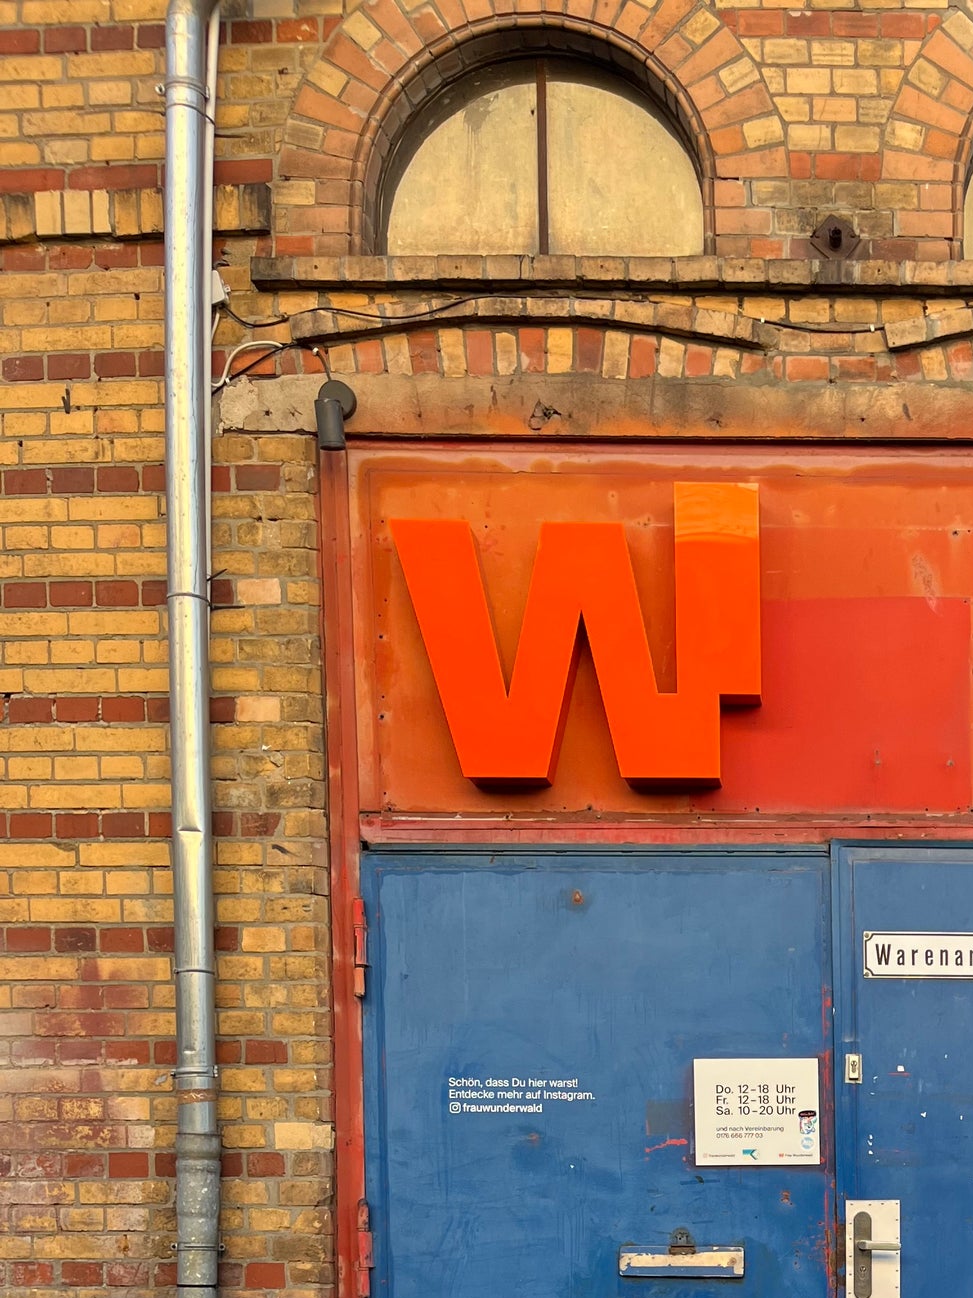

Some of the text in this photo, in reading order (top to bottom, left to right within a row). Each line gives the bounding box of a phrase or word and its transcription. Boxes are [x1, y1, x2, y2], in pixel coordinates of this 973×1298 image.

[448, 1077, 579, 1088] Schön, dass Du hier warst!
[715, 1084, 734, 1094] Do.
[776, 1084, 796, 1094] Uhr
[448, 1089, 596, 1101] Entdecke mehr auf Instagram.
[716, 1095, 729, 1104] Fr.
[776, 1095, 796, 1104] Uhr
[462, 1103, 543, 1113] frauwunderwald
[715, 1106, 734, 1115] Sa.
[776, 1106, 796, 1115] Uhr
